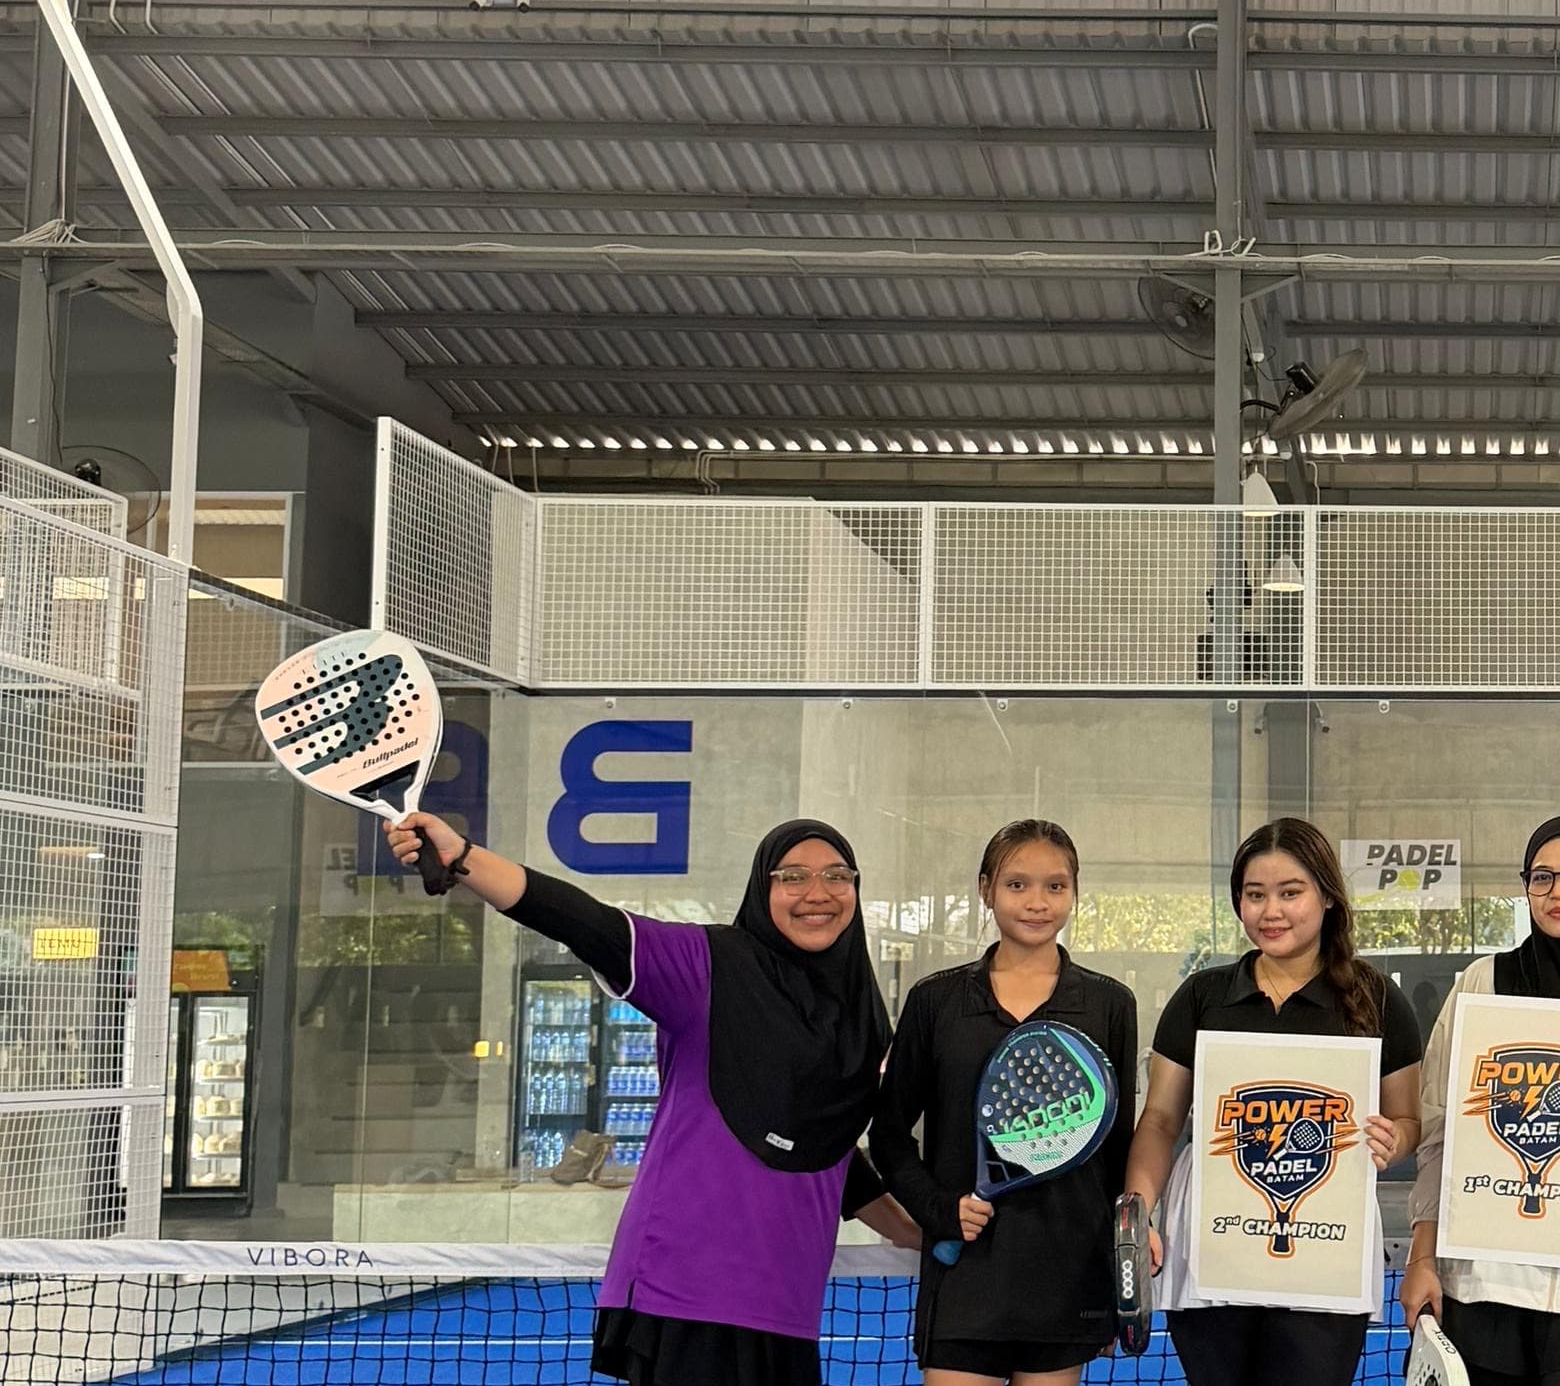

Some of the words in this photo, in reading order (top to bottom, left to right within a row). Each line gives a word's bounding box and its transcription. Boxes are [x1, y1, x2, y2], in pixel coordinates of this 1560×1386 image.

[363, 738, 419, 768] Bullpadel
[1366, 844, 1457, 866] PADEL
[1221, 1098, 1348, 1125] POWER
[1519, 1136, 1557, 1145] BATAM
[1250, 1158, 1318, 1177] PADEL
[1266, 1173, 1305, 1183] BATAM
[1464, 1175, 1491, 1193] 1st
[1213, 1216, 1241, 1233] 2nd
[1243, 1218, 1346, 1241] CHAMPION
[247, 1248, 374, 1268] VIBORA
